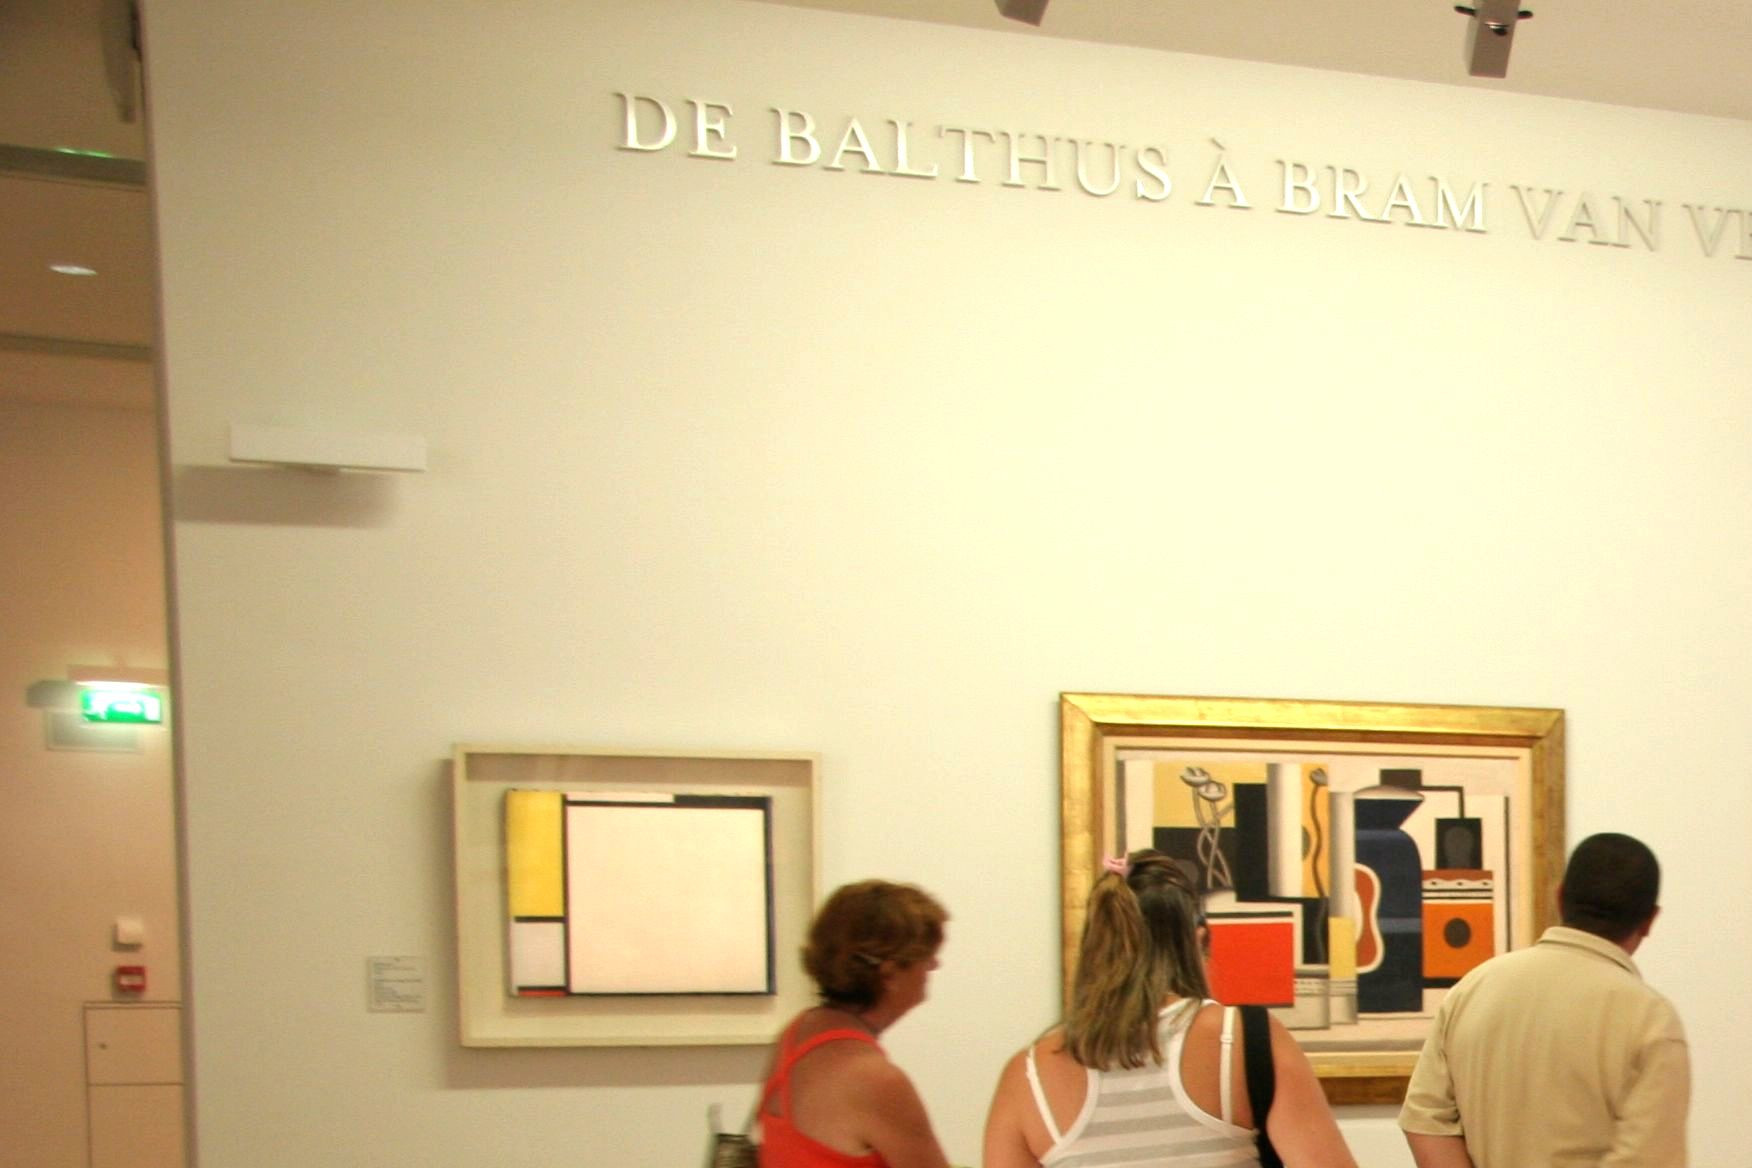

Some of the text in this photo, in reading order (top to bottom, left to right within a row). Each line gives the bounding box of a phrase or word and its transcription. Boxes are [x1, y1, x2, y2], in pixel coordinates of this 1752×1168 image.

[616, 91, 738, 161] DE
[769, 107, 1173, 201] BALTHUS
[1195, 137, 1253, 210] À
[1274, 159, 1491, 233] BRAM
[1509, 184, 1662, 251] VAN
